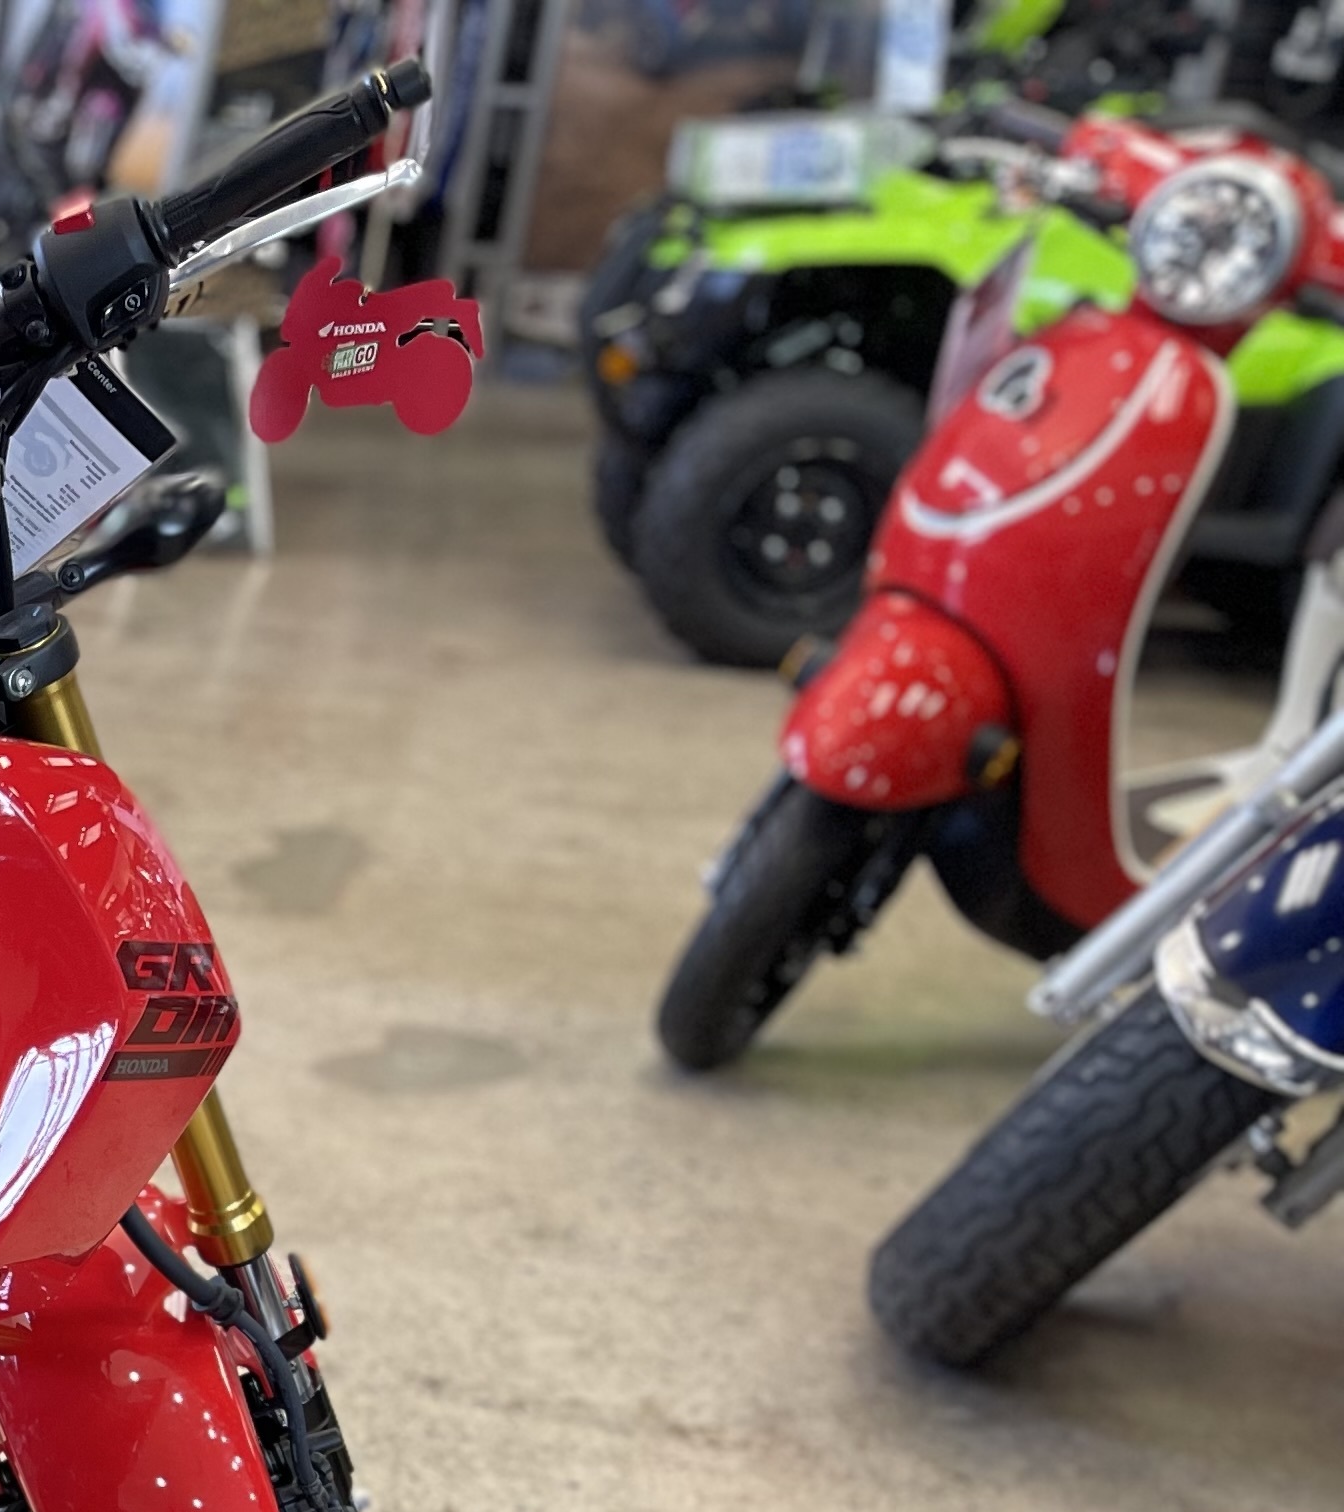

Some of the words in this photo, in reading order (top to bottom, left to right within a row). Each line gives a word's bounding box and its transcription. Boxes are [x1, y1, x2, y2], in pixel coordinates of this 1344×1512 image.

[333, 321, 387, 337] HONDA
[355, 345, 375, 364] GO
[87, 361, 118, 394] Center
[114, 1058, 169, 1074] HONDA
